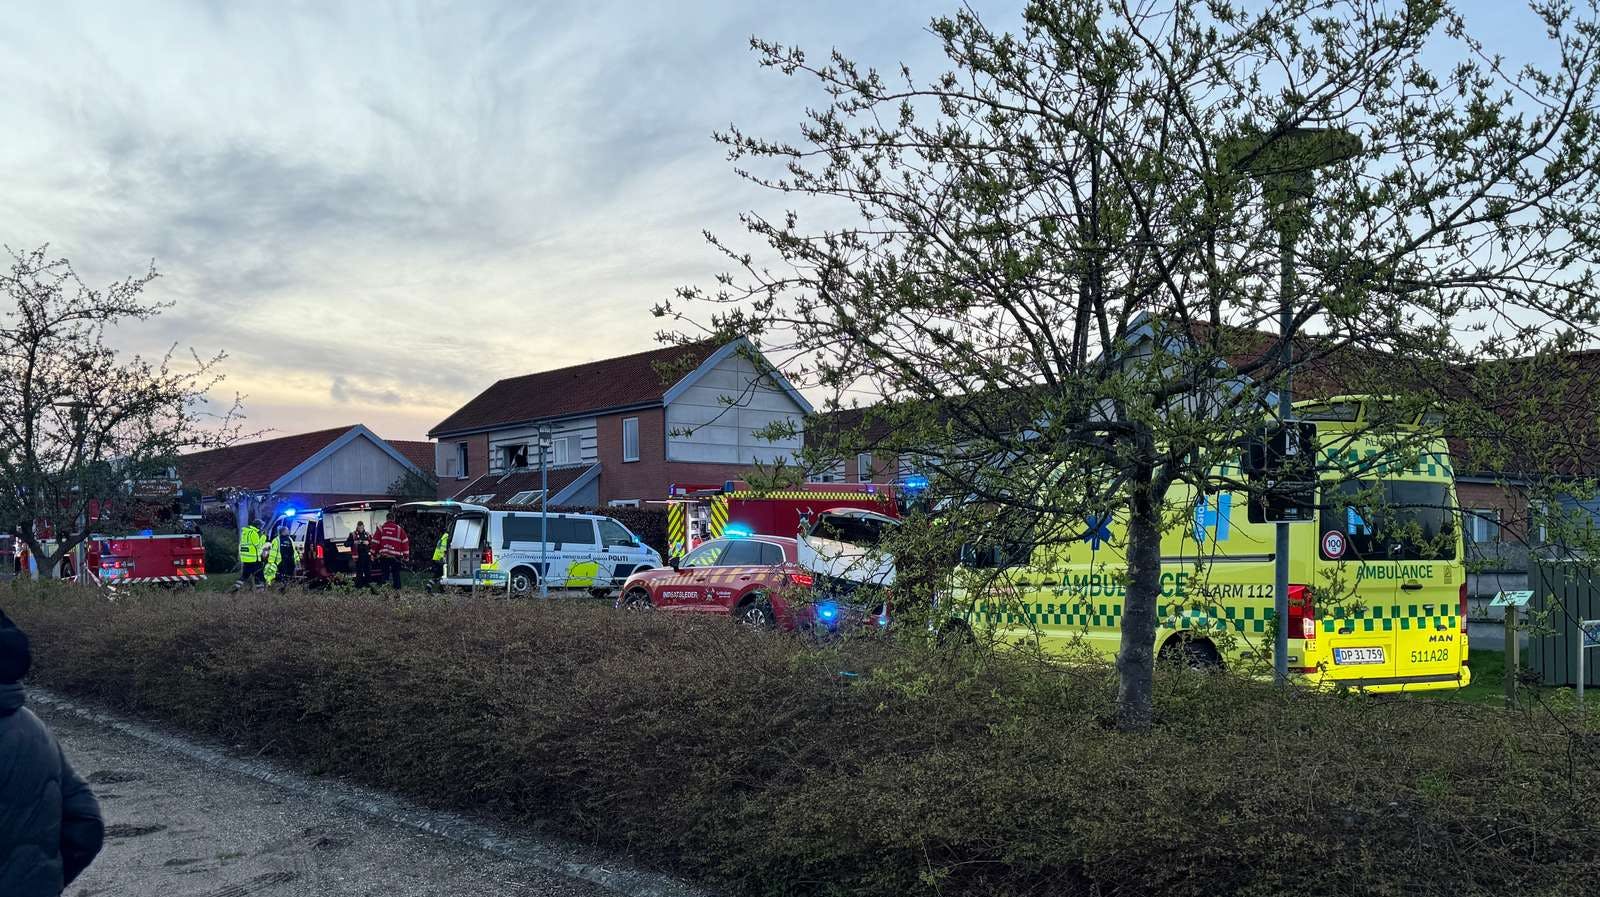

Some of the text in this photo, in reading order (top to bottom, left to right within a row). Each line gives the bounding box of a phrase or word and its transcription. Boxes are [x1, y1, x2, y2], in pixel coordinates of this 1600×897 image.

[1328, 539, 1342, 548] 100
[608, 554, 629, 562] POLITI
[1356, 564, 1434, 580] AMBULANCE
[1196, 584, 1274, 598] ALARM 112
[1429, 634, 1453, 642] MAN
[1340, 649, 1383, 660] DP 31 759
[1410, 648, 1449, 663] 511A28
